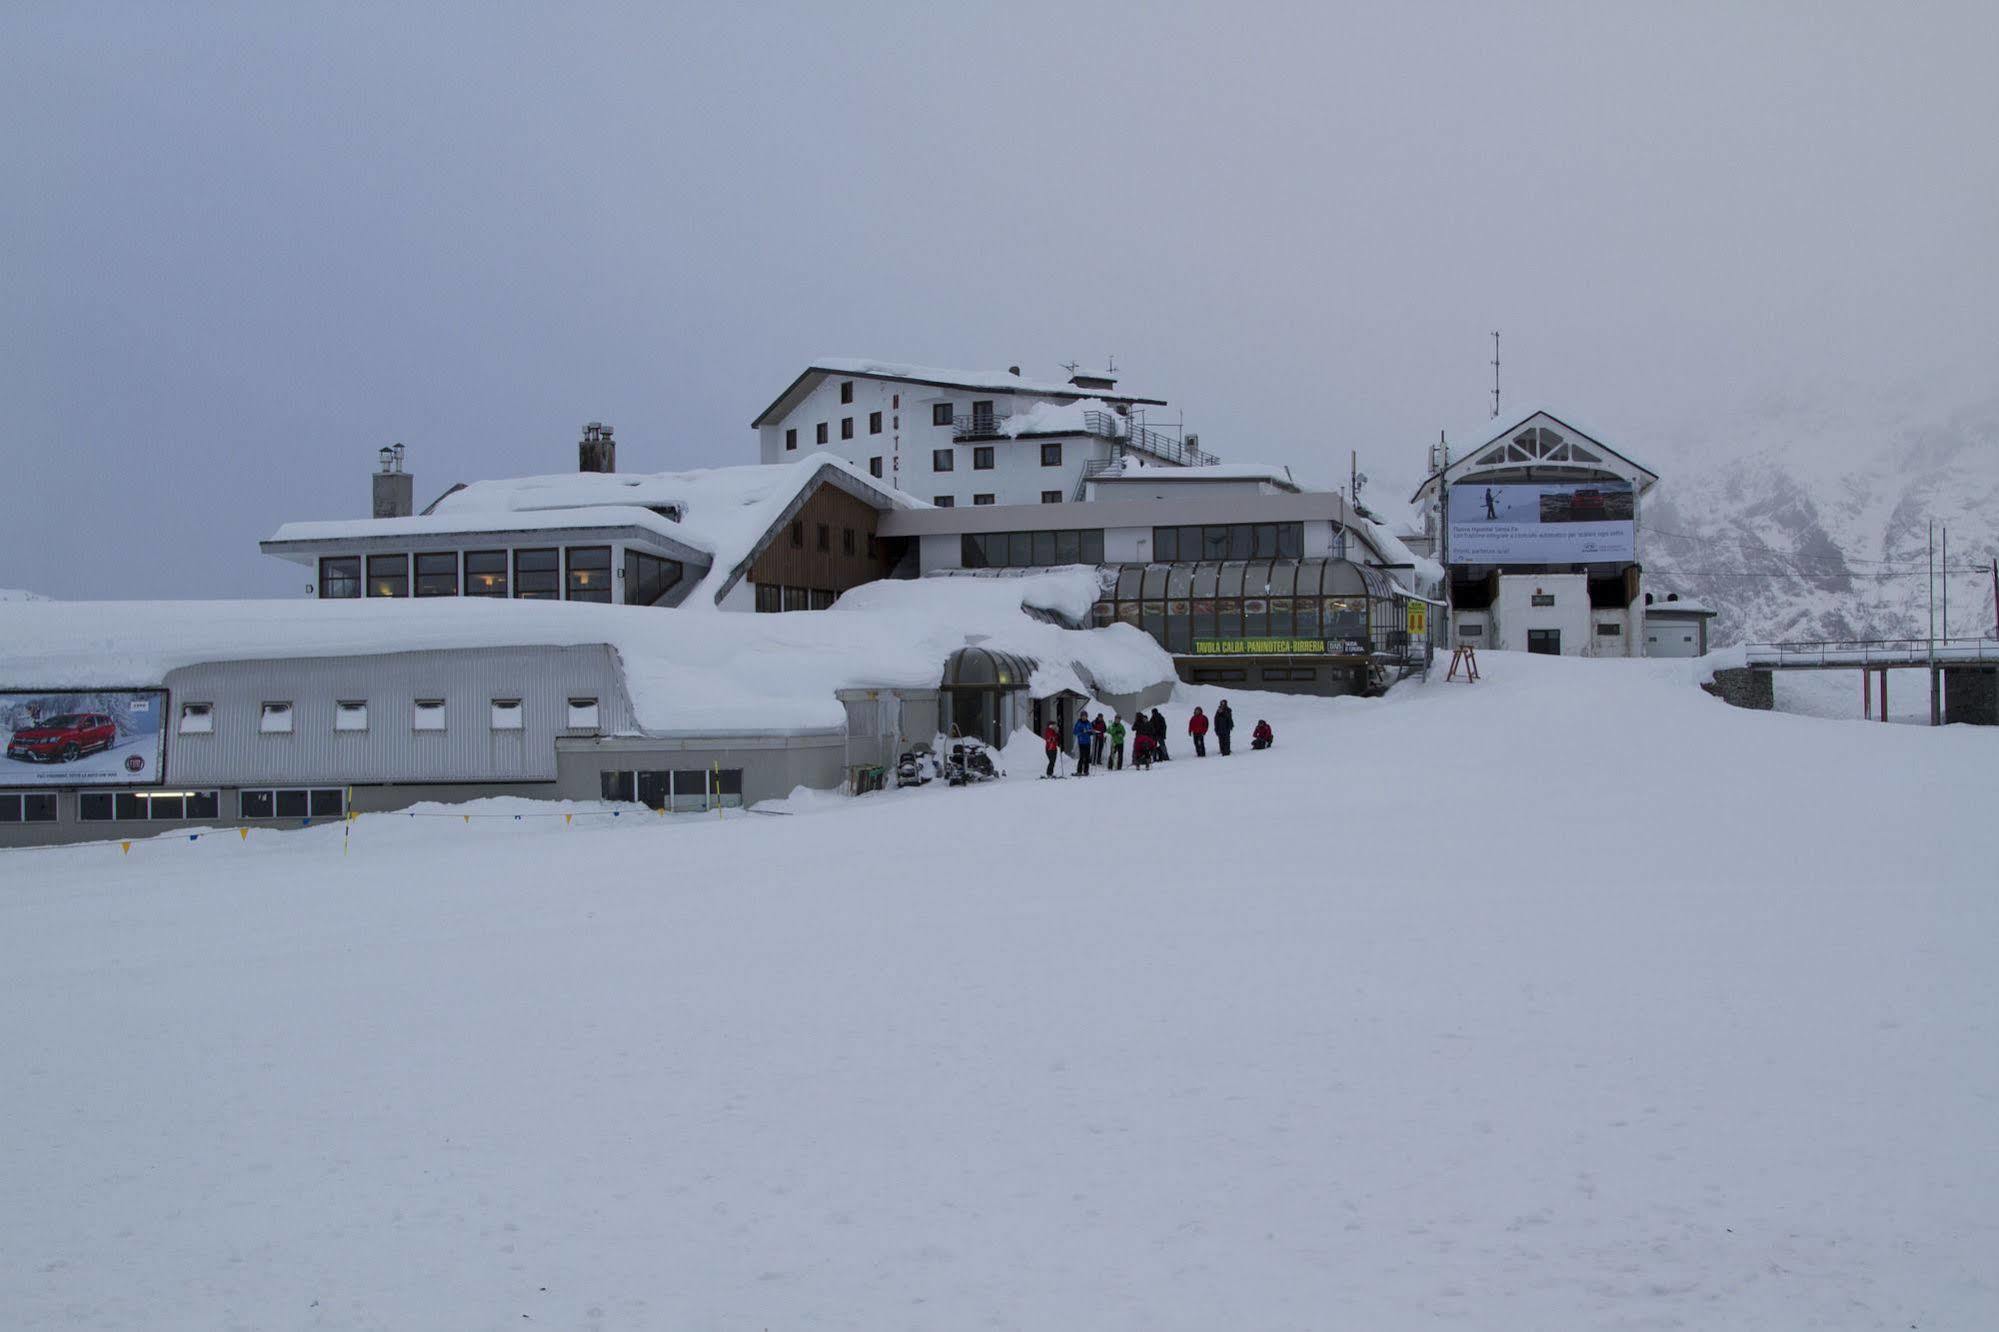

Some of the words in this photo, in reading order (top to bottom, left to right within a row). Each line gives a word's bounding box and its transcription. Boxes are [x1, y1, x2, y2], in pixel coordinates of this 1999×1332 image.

[1196, 641, 1220, 654] TAVOLA
[1222, 641, 1245, 653] CALDA
[1292, 640, 1325, 652] BIRRERIA
